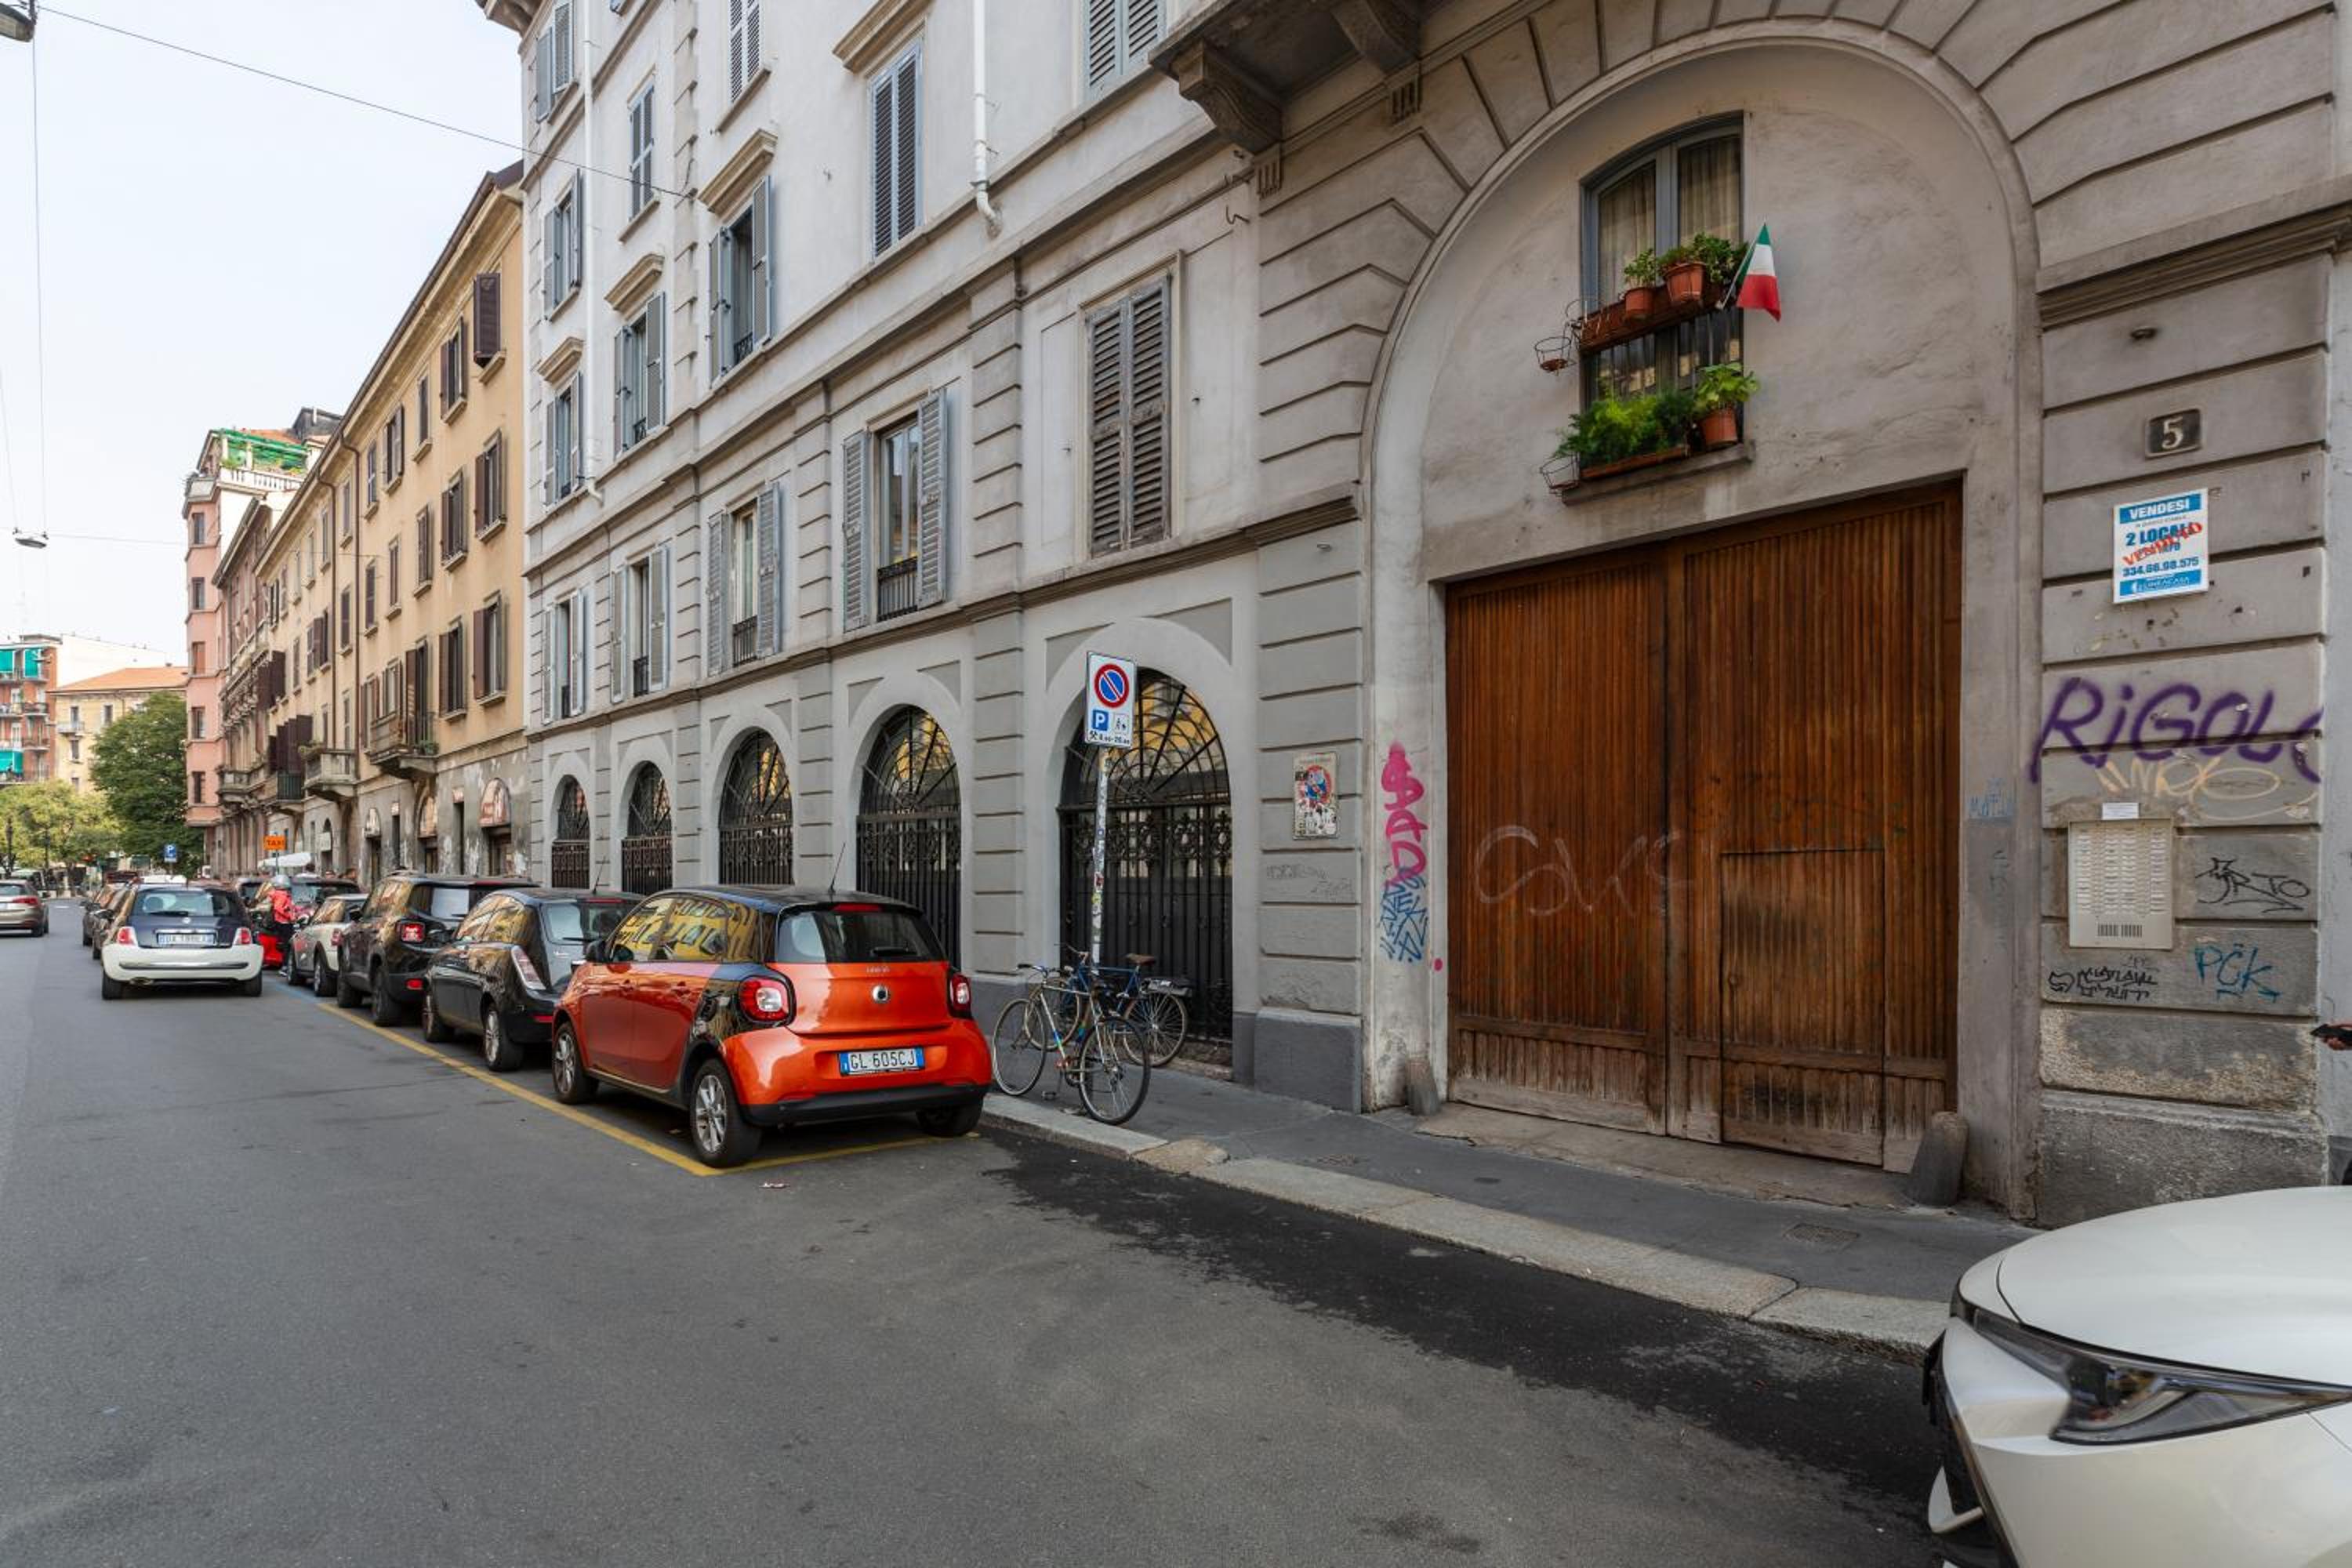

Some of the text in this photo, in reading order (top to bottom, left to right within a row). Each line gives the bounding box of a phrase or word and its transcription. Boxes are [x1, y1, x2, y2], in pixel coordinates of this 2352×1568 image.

[2161, 416, 2183, 449] 5
[2129, 499, 2190, 519] VENDESI
[2125, 532, 2136, 546] 2
[1095, 713, 1105, 728] P
[850, 1054, 868, 1069] GL
[872, 1051, 916, 1067] 605CJ
